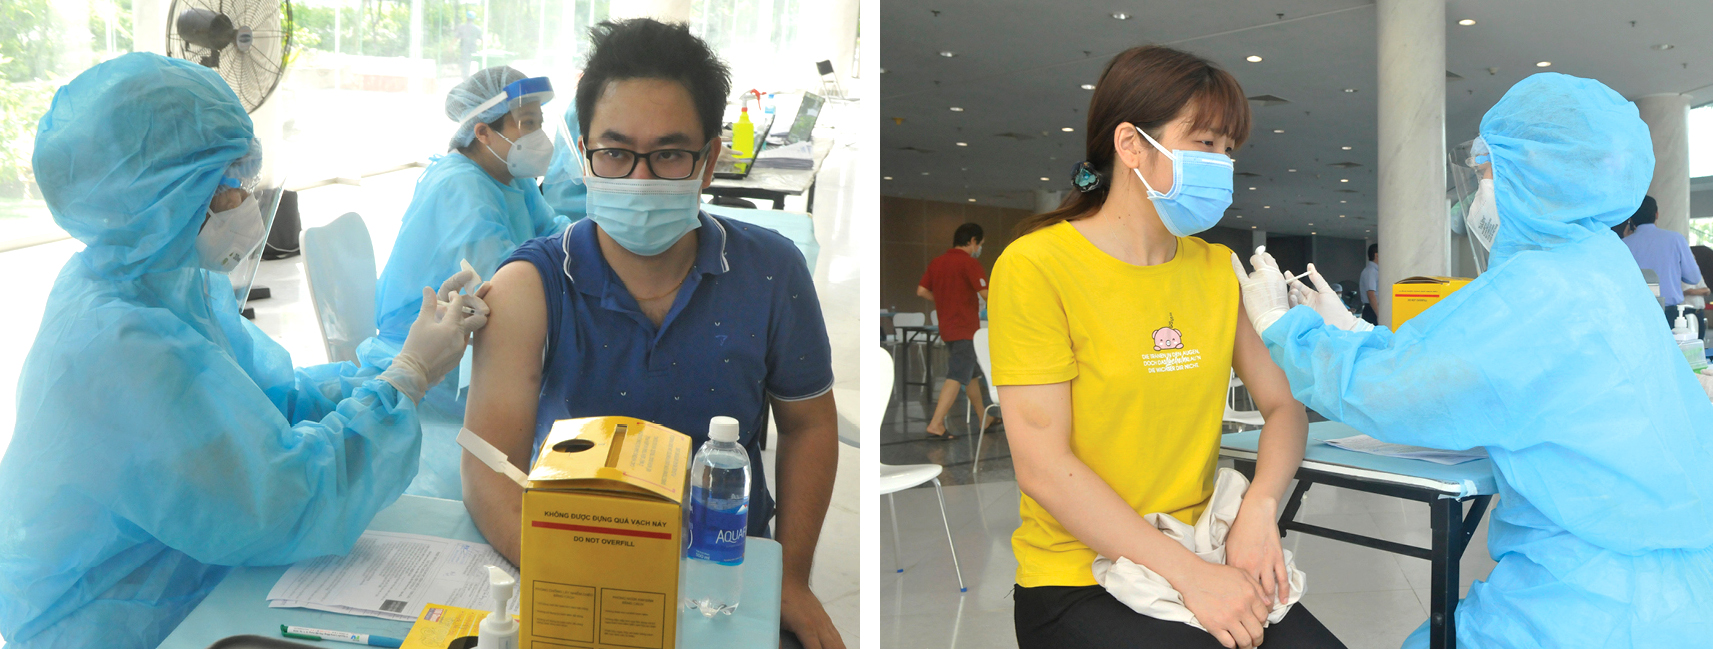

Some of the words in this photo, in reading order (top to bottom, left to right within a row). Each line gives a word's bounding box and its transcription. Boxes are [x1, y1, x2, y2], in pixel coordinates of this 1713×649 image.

[544, 510, 570, 519] KHÔNG
[631, 519, 651, 527] VẠCH
[573, 535, 584, 543] DO
[601, 538, 635, 548] OVERFILL
